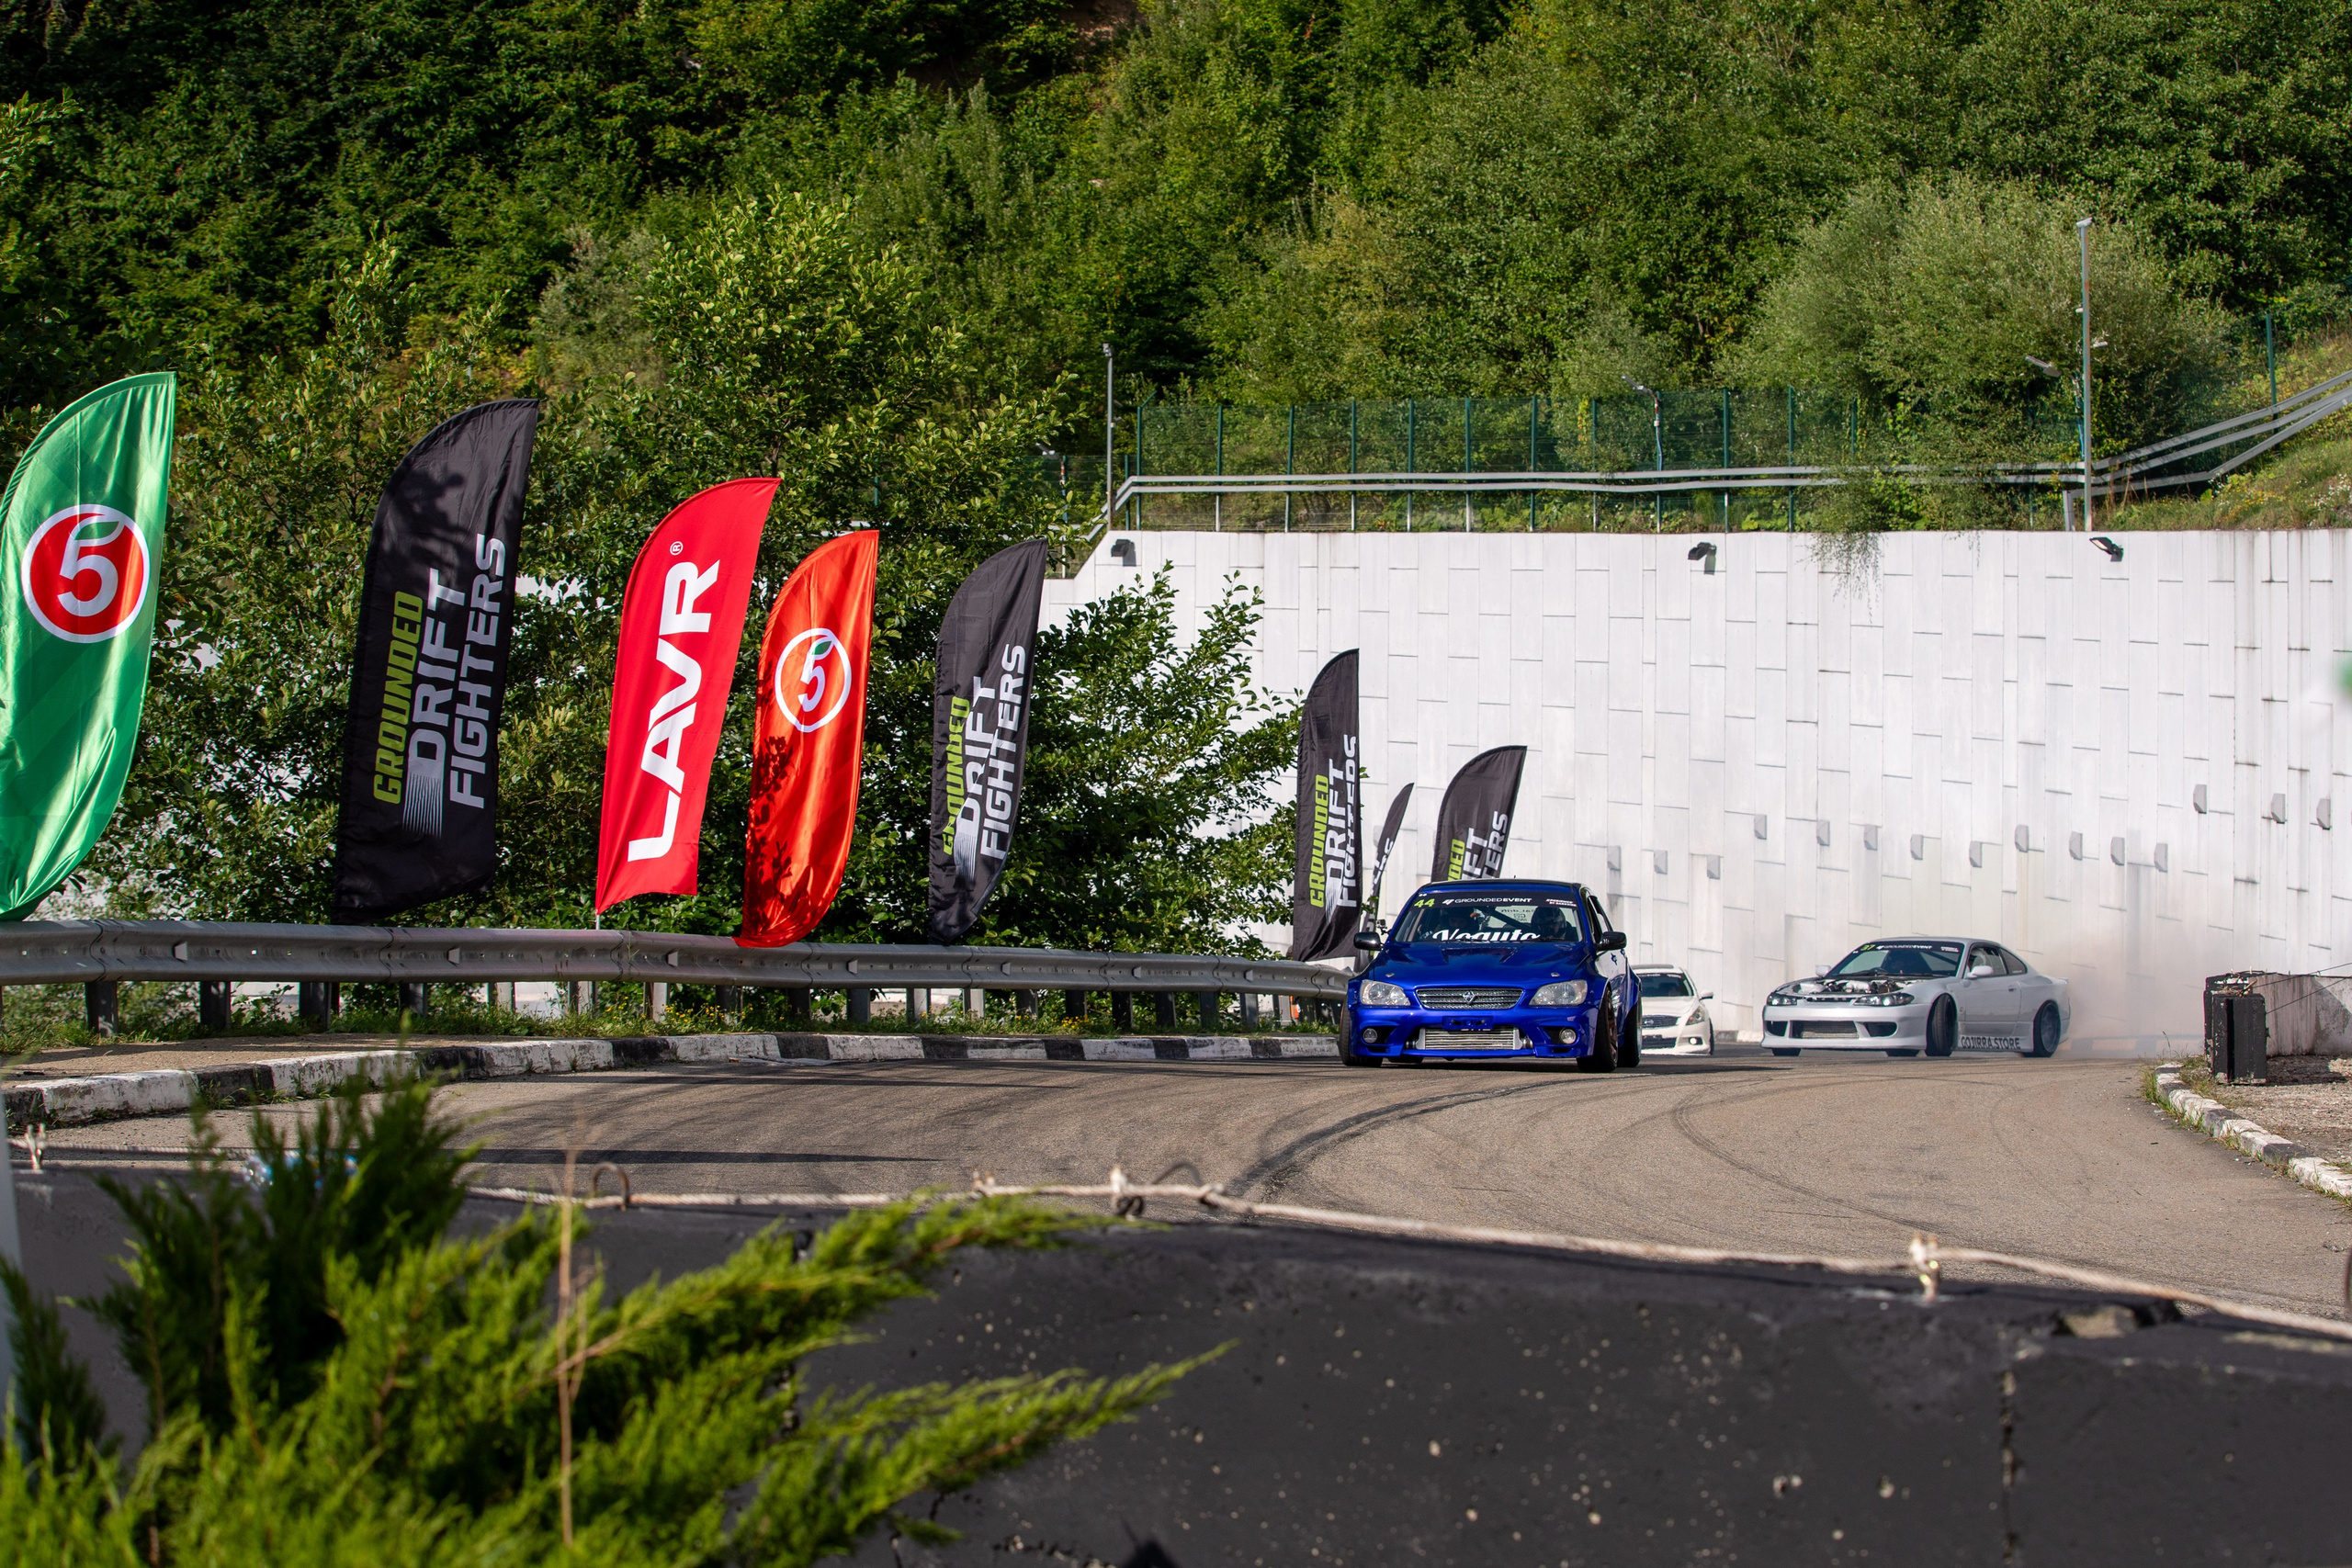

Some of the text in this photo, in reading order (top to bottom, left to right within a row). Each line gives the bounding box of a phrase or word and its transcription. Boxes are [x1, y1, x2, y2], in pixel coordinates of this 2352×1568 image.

[57, 514, 125, 616] 5
[373, 591, 423, 805] GROUNDED
[405, 568, 466, 810] DRIFT
[450, 533, 506, 809] FIGHTERS
[797, 636, 835, 713] 5
[943, 696, 970, 856] GROUNDED
[954, 676, 996, 859] DRIFT
[980, 644, 1026, 860] FIGHTERS
[1325, 759, 1346, 905] DRIFT
[1309, 774, 1329, 908] GROUNDED
[1414, 898, 1435, 908] 44
